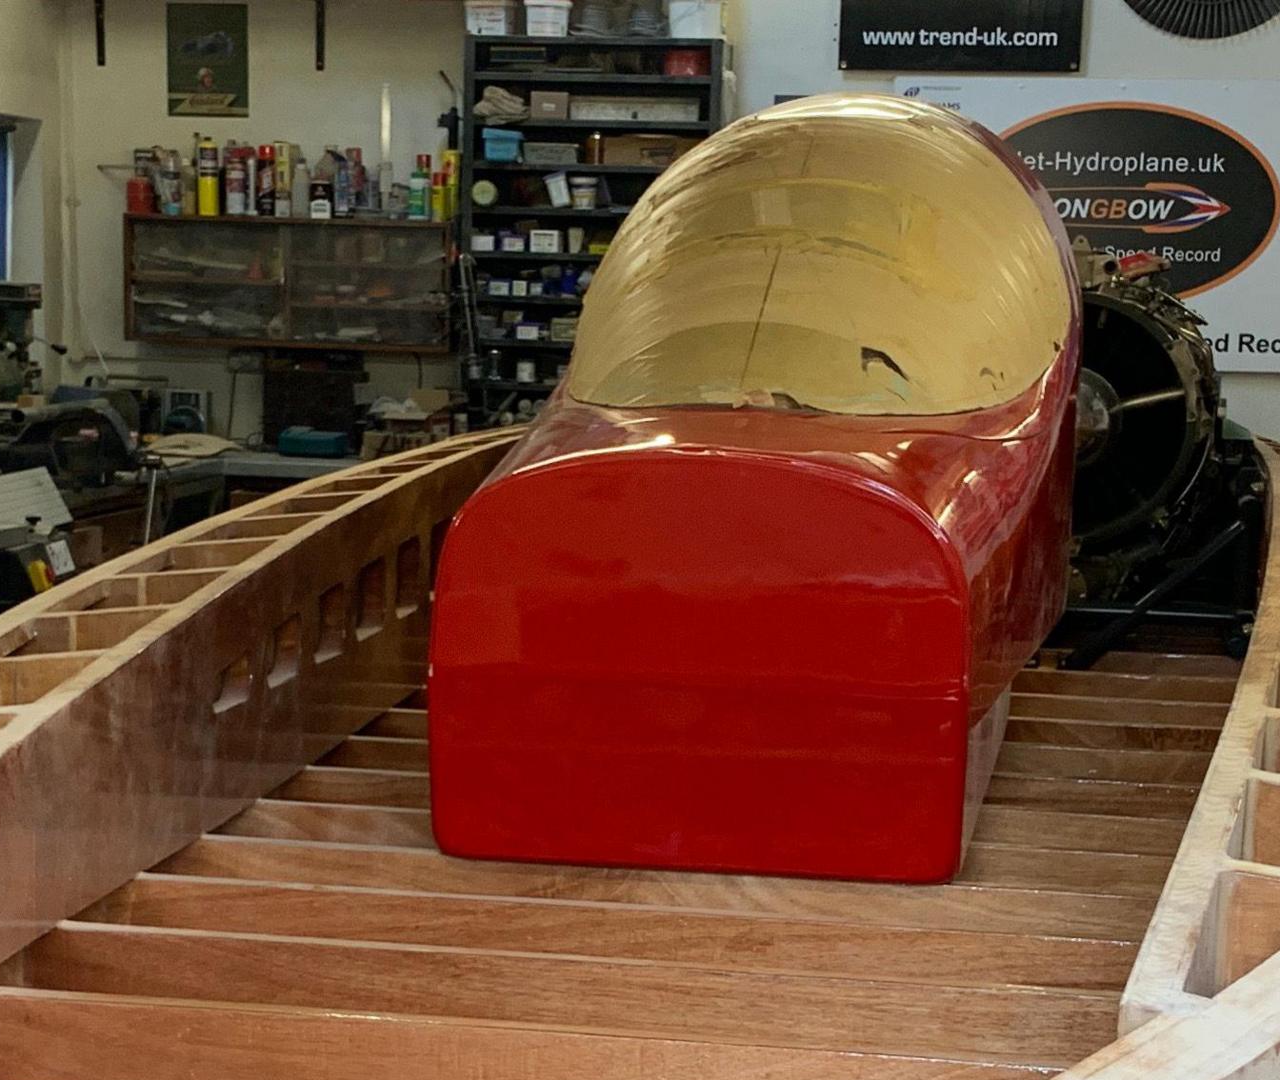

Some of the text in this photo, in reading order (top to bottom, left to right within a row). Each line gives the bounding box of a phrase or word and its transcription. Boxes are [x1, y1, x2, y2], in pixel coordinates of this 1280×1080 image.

[1054, 197, 1174, 220] ONGBOW
[1104, 245, 1221, 263] Spe Record
